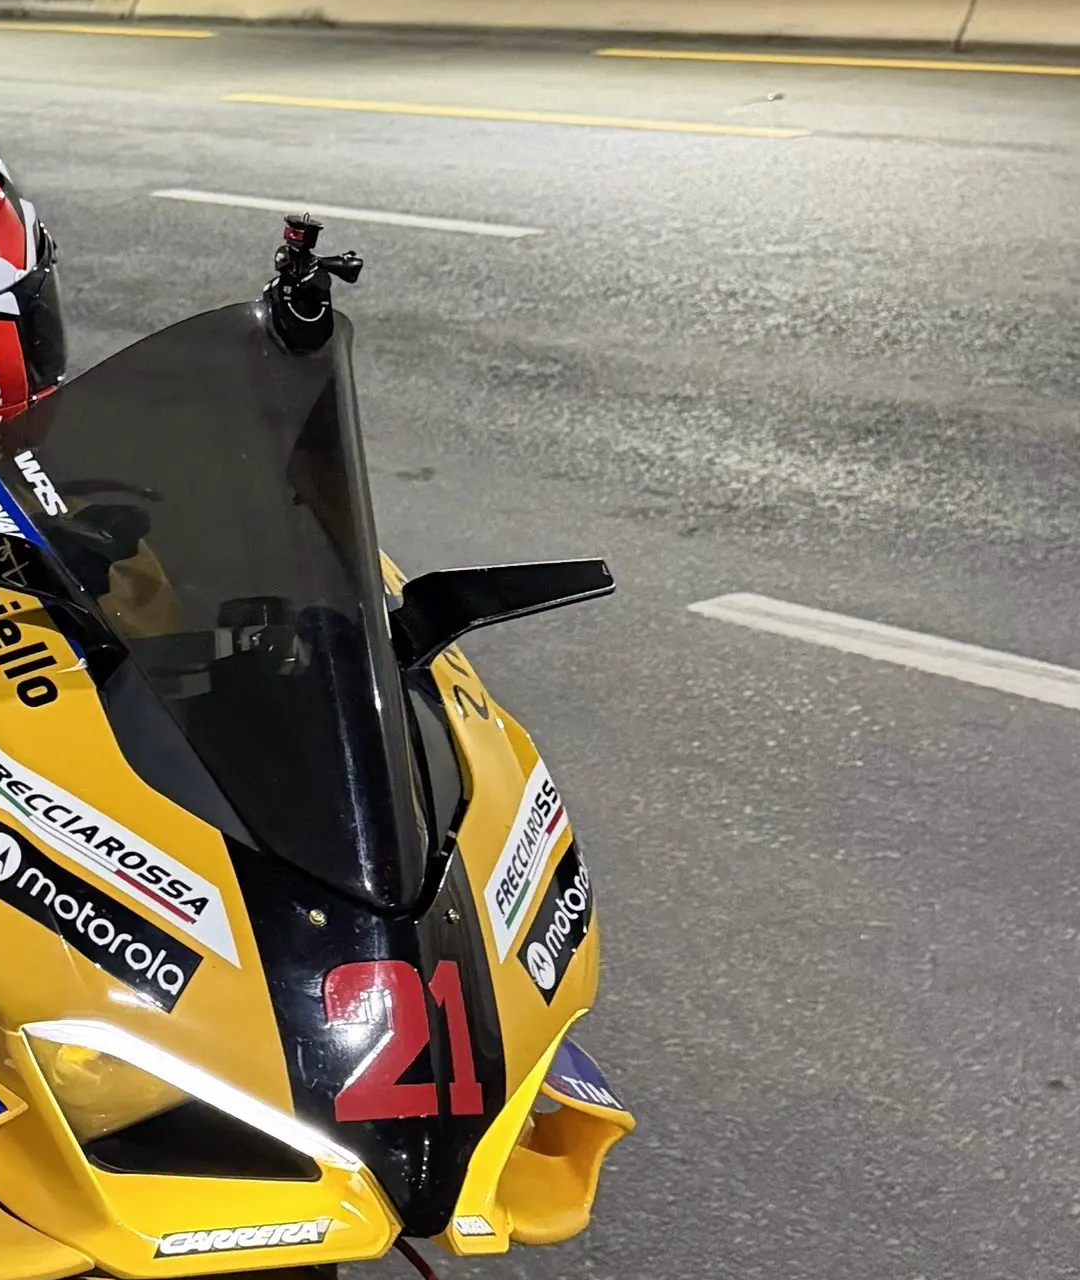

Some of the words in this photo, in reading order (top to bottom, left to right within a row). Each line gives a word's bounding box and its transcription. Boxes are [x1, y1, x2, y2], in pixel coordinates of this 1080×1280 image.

[14, 450, 68, 516] WRS
[16, 867, 185, 996] motorola
[324, 960, 484, 1121] 21
[561, 1074, 624, 1109] TIM
[158, 1219, 328, 1255] CARRERA
